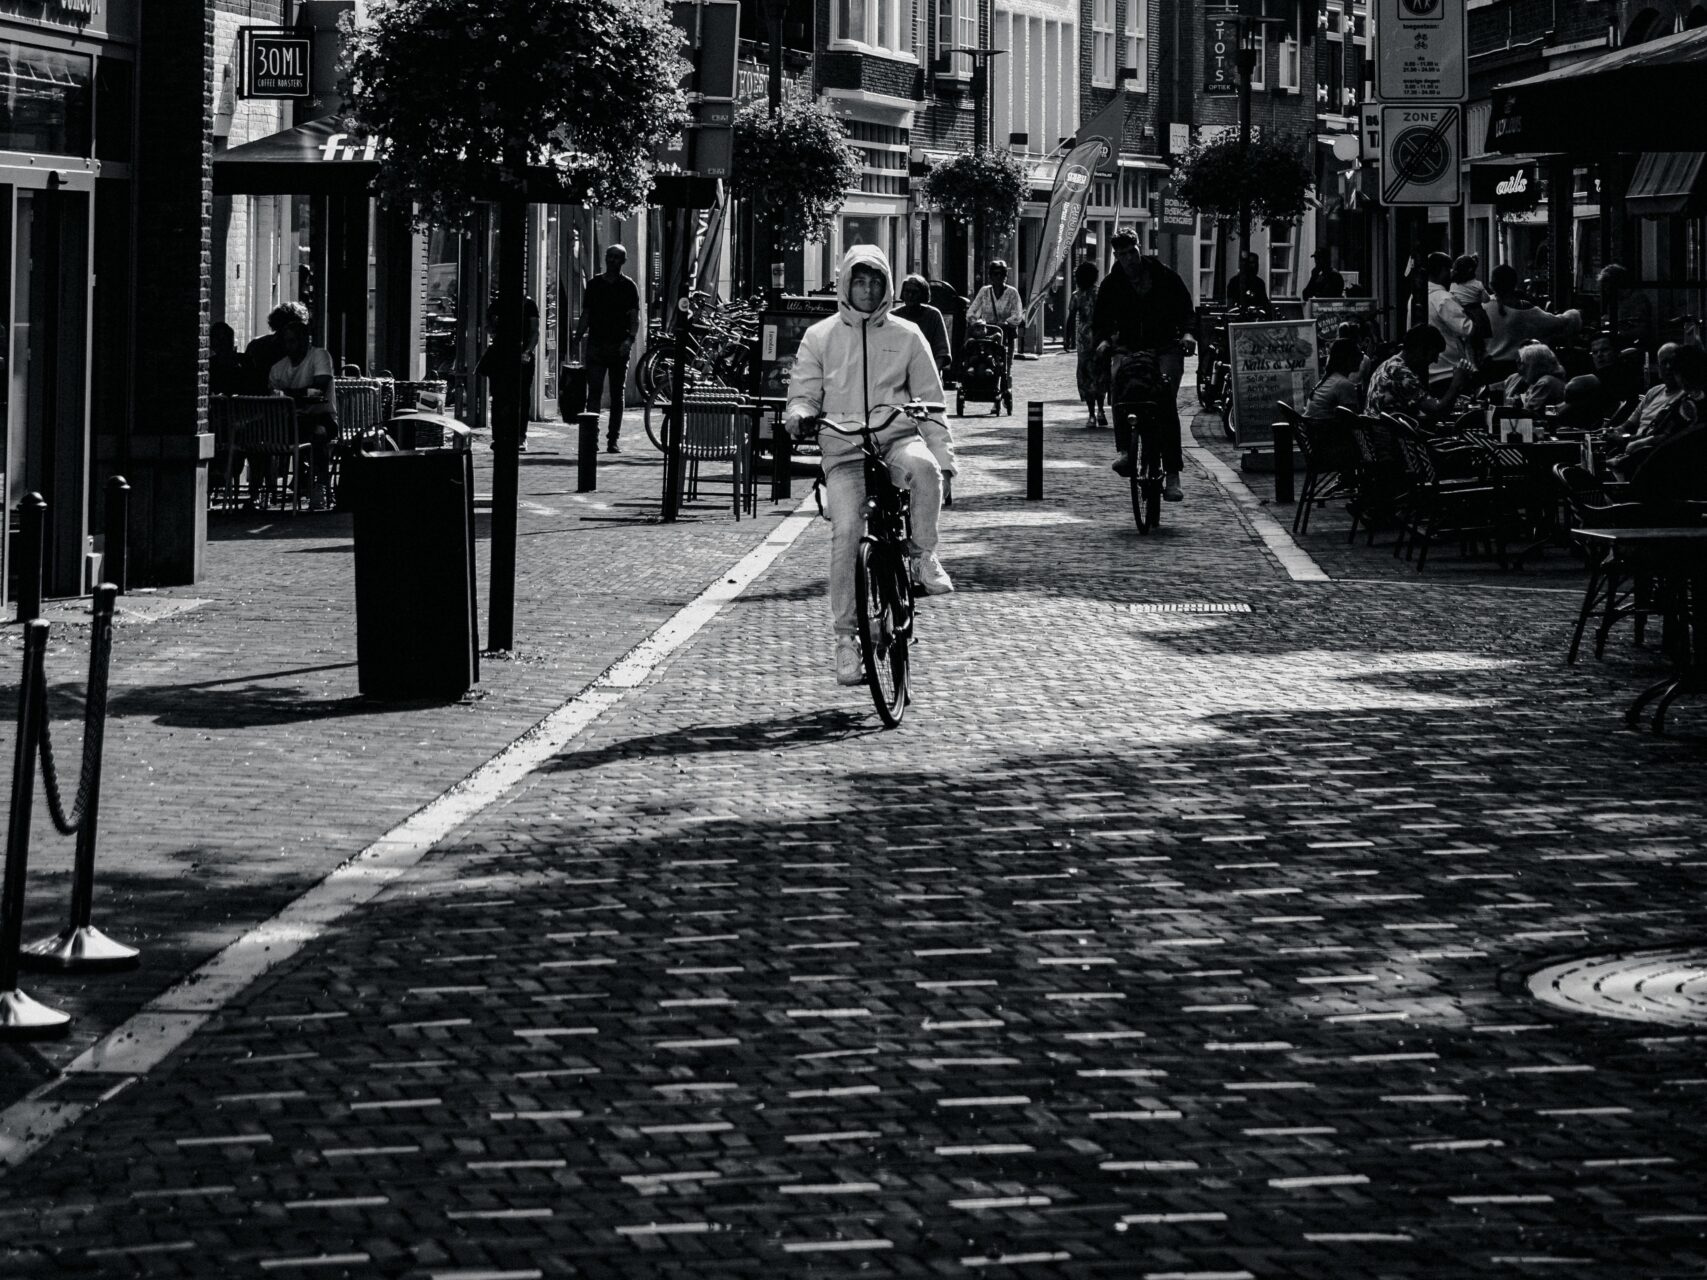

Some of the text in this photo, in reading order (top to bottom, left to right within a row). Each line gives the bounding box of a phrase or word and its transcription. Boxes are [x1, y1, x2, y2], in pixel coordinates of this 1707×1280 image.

[257, 46, 304, 76] 30ML
[257, 78, 303, 88] COFFEE ROASTERS
[1402, 112, 1438, 122] ZONE
[1243, 359, 1270, 371] Nails
[1284, 358, 1306, 371] Spa
